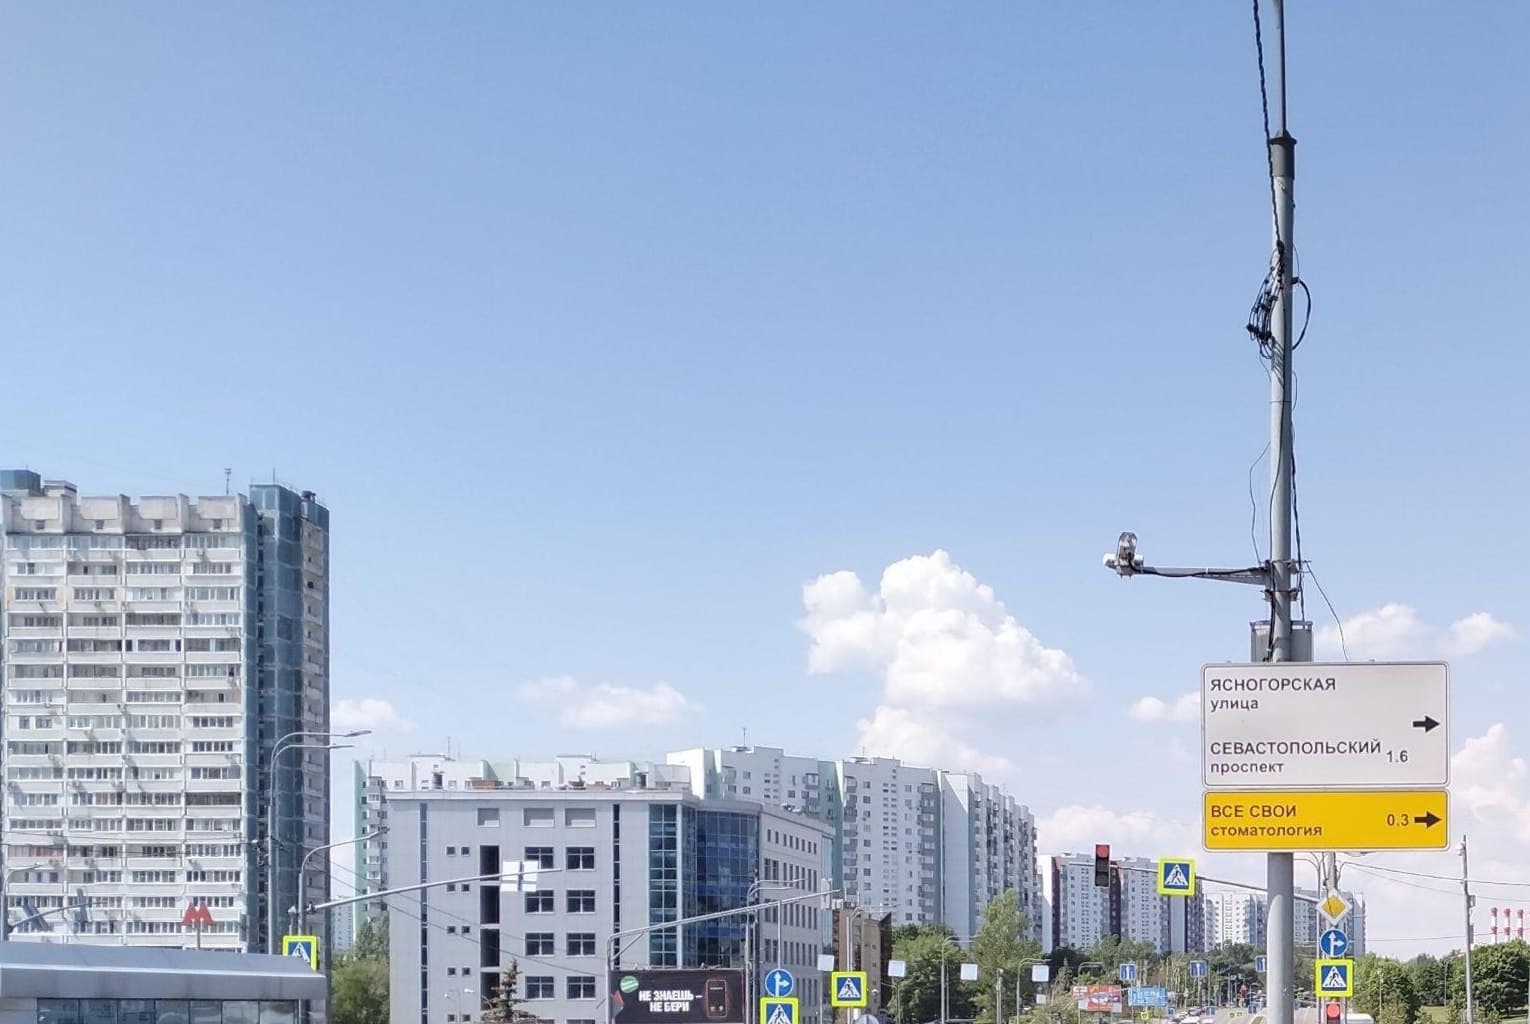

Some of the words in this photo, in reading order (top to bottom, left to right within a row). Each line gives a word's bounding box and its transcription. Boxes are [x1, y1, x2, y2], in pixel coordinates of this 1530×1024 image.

[1210, 678, 1336, 691] ЯСНОГОРСКАЯ
[1210, 698, 1259, 712] улица
[1210, 738, 1381, 755] СЕВАСТОПОЛЬСКИЙ
[1386, 750, 1408, 763] 1.6
[1210, 762, 1284, 775] проспект
[1211, 805, 1244, 818] ВСЕ
[1250, 805, 1297, 818] СВОИ
[1387, 814, 1409, 827] 0.3
[1210, 824, 1322, 837] стоматология
[639, 990, 653, 1001] НЕ
[653, 990, 694, 1001] ЗНАЕШЬ
[649, 1001, 663, 1012] НЕ
[664, 1001, 690, 1012] БЕРИ
